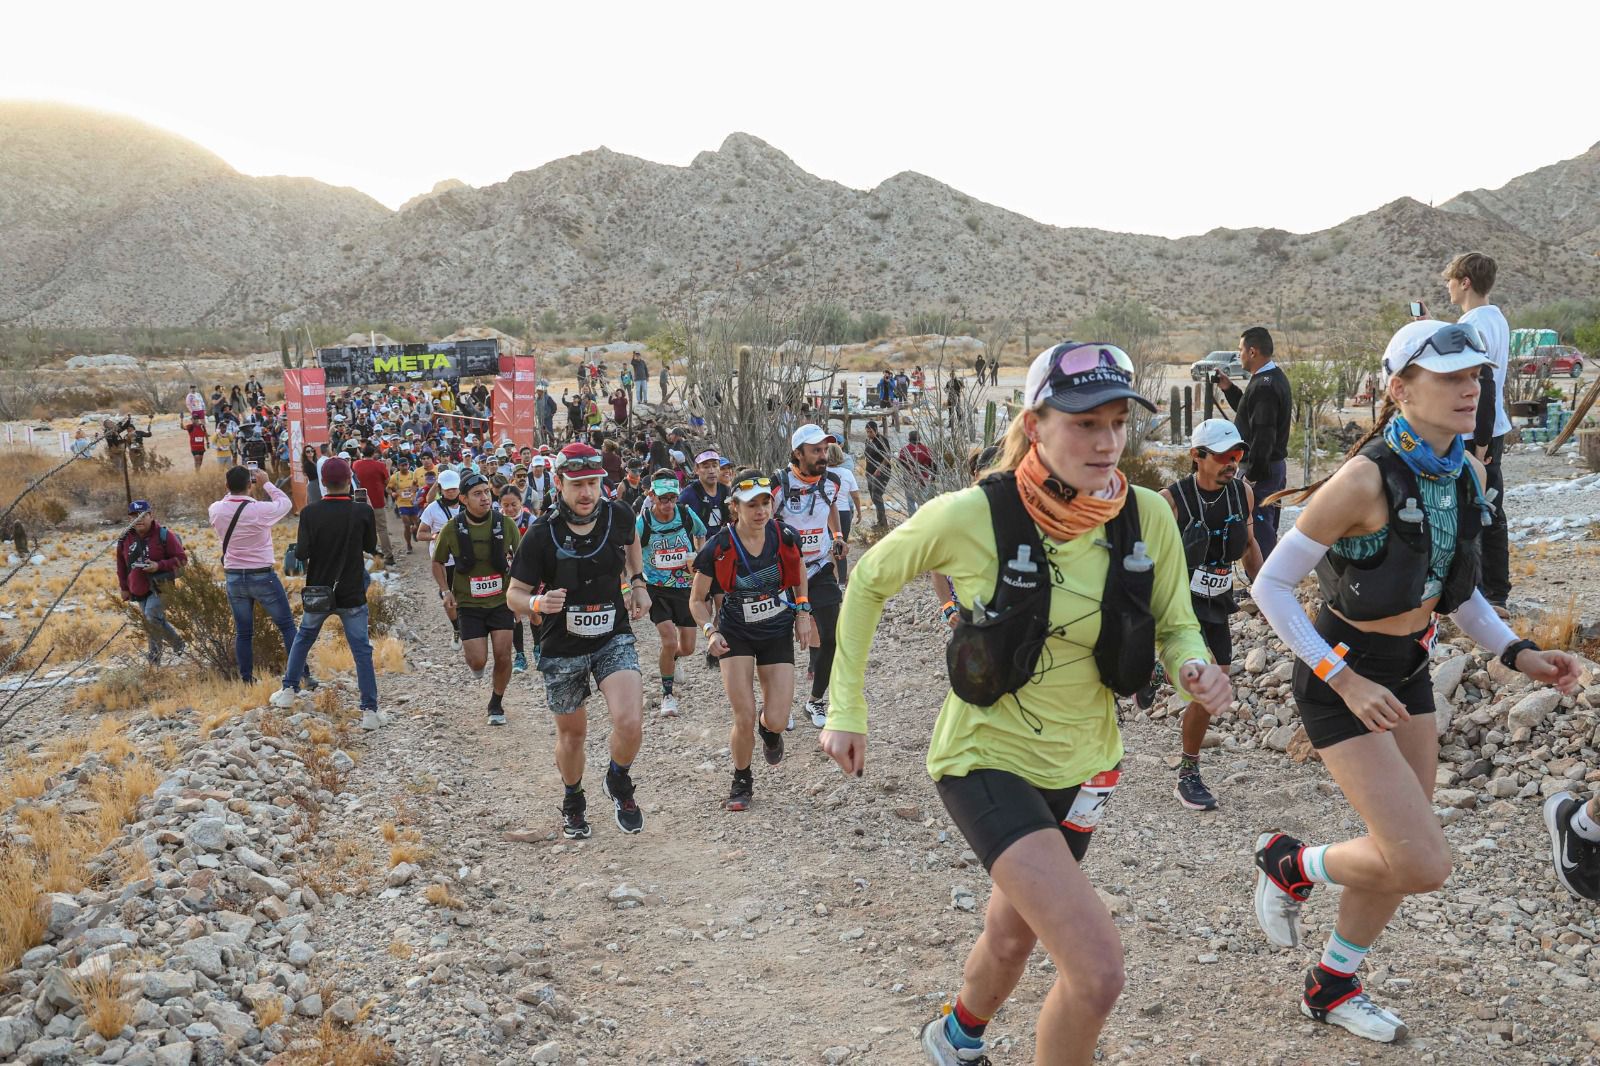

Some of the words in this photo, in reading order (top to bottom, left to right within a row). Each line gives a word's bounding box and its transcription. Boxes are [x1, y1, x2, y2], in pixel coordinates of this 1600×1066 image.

[373, 353, 451, 373] META
[799, 535, 819, 545] 033
[660, 553, 683, 562] 7040
[475, 580, 498, 590] 3018
[751, 600, 778, 614] 501
[574, 613, 609, 626] 5009
